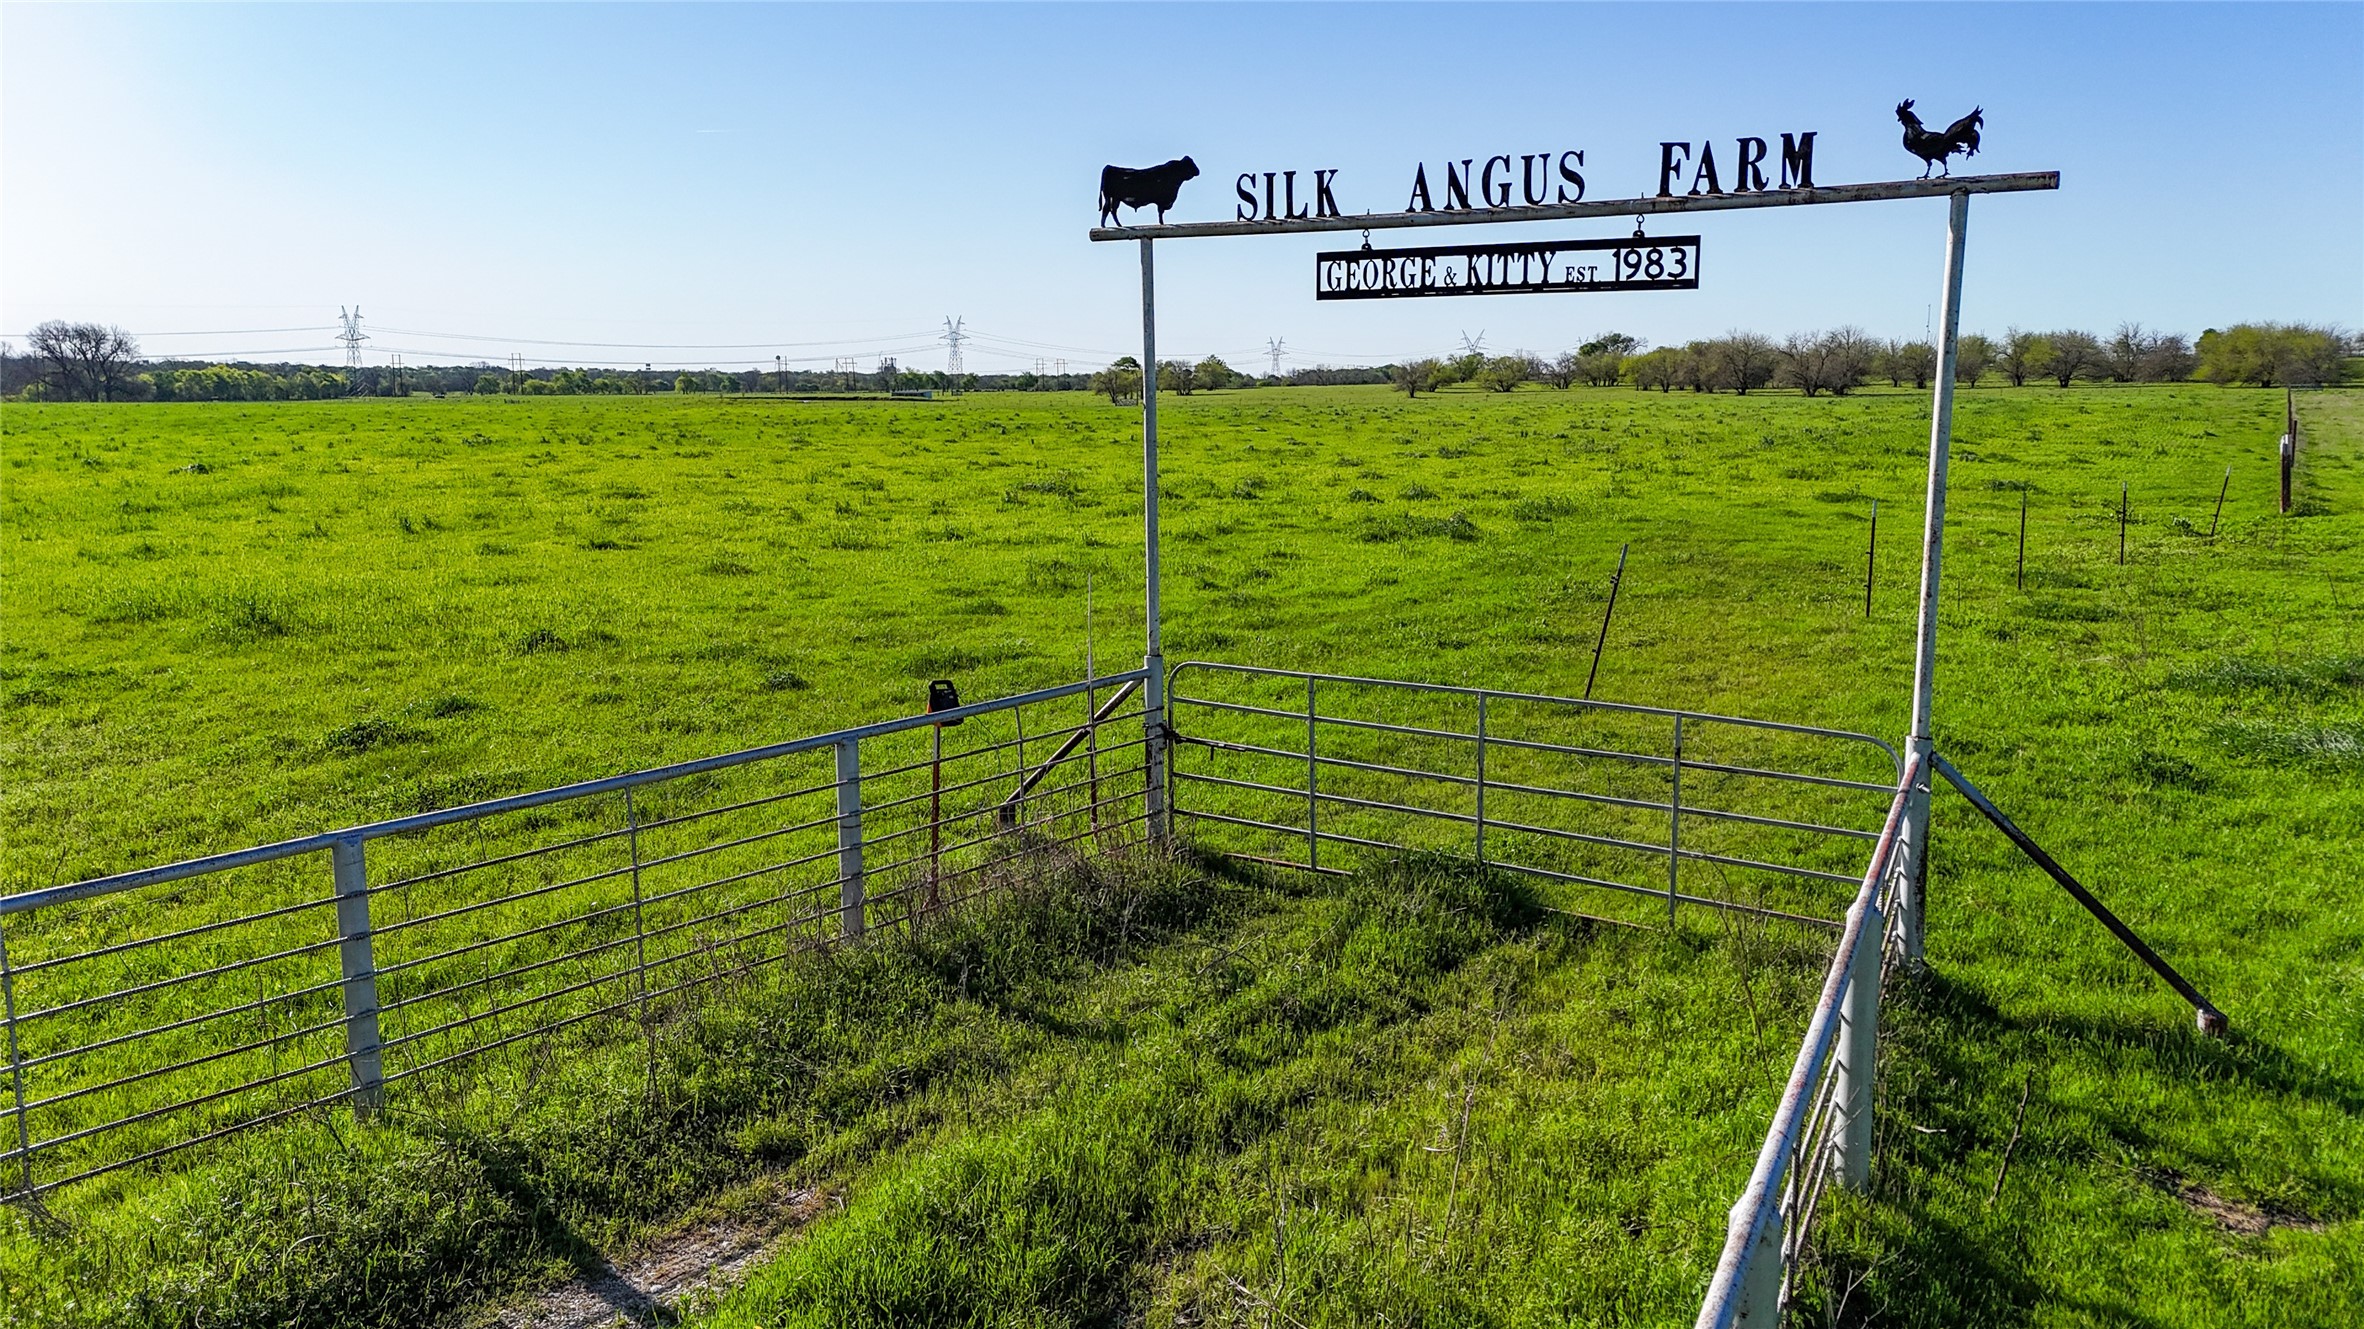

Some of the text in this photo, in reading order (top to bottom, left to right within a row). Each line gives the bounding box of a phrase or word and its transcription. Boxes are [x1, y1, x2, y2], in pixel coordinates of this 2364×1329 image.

[1236, 131, 1818, 221] SILK ANGUS FARM
[1326, 246, 1688, 292] GEORGE & KITTY EST 1983
